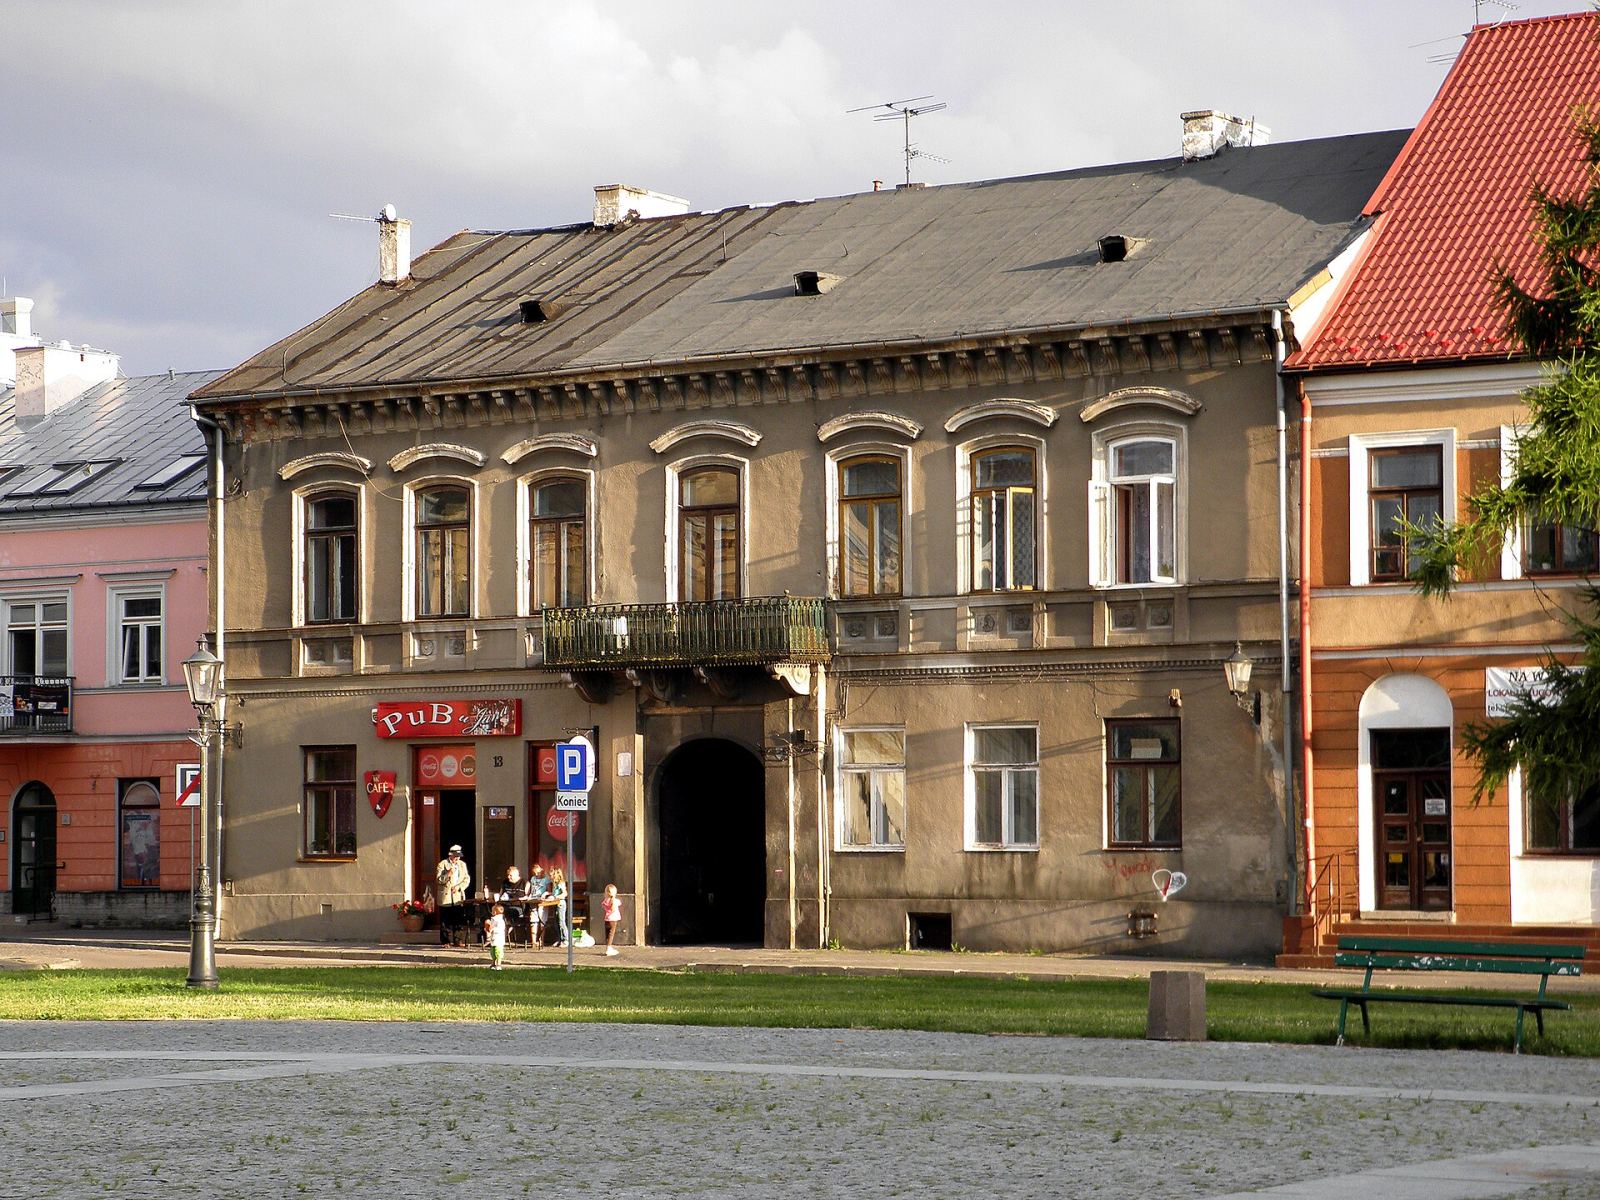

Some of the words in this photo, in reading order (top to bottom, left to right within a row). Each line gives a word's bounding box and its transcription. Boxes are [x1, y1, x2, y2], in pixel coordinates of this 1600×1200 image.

[1509, 672, 1527, 681] NA
[493, 755, 504, 767] 13
[563, 749, 581, 784] P
[557, 796, 587, 807] Koniec
